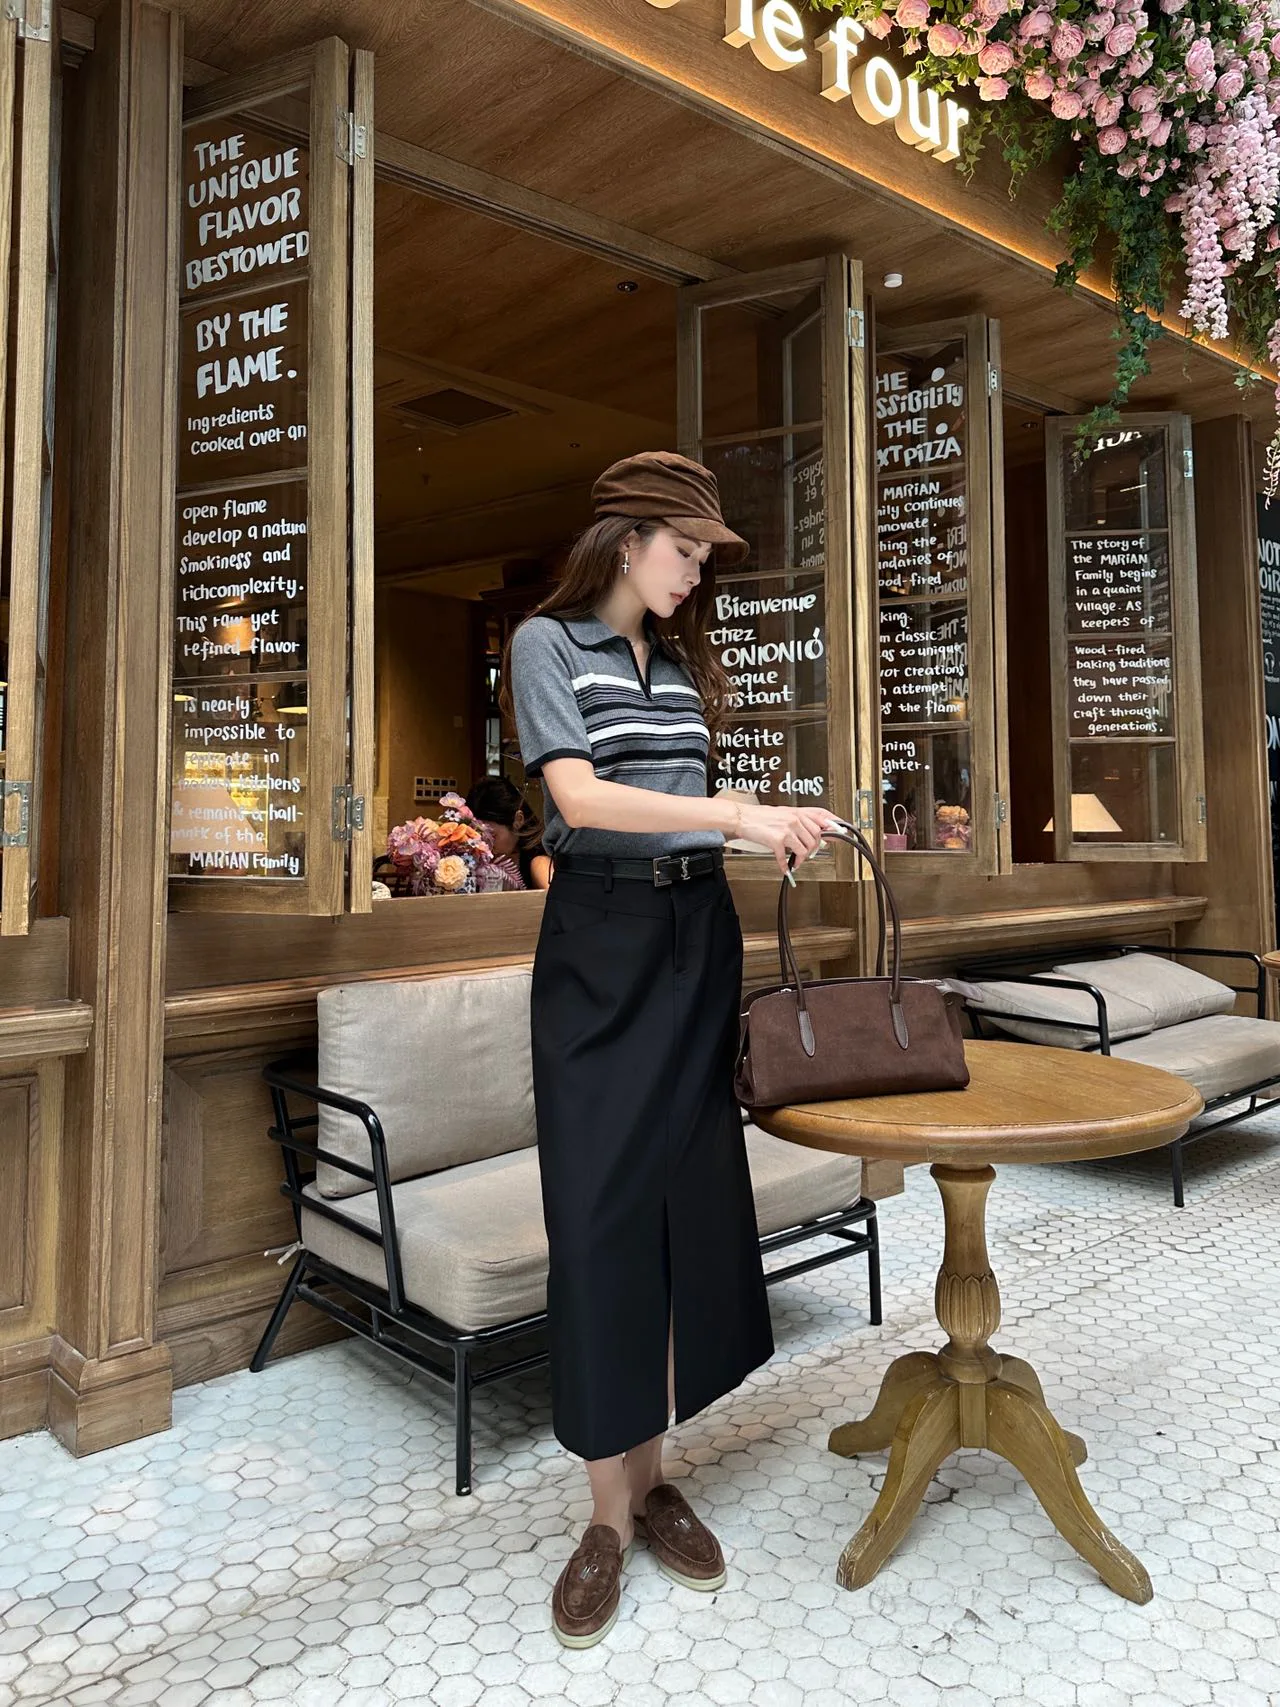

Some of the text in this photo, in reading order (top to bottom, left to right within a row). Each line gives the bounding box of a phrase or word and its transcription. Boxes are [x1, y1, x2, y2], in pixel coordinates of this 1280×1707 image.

[815, 17, 969, 163] four
[194, 133, 246, 171] THE
[198, 187, 301, 246] FLAVOR
[185, 230, 309, 290] BESTOWED
[196, 303, 288, 352] BY THE
[196, 346, 297, 399] FLAME.
[287, 425, 307, 441] an
[883, 418, 927, 439] THE
[183, 500, 267, 524] open flame
[904, 496, 964, 513] continues
[183, 528, 242, 547] develop
[248, 525, 258, 540] a
[912, 537, 937, 548] the
[1071, 538, 1145, 551] The story of
[263, 543, 291, 563] and
[937, 551, 953, 564] of
[1073, 555, 1093, 564] the
[1075, 568, 1157, 583] Family begins
[1076, 584, 1143, 598] in a quaint
[715, 594, 817, 621] Bienvenue
[177, 609, 280, 632] This raw yet
[1140, 616, 1155, 628] of
[895, 631, 937, 643] classic
[184, 637, 300, 661] refined flavor
[899, 649, 915, 657] to
[917, 644, 962, 660] unique
[904, 664, 965, 677] creations
[1076, 660, 1116, 673] baking
[892, 681, 948, 697] attempt
[1073, 676, 1096, 689] they
[1102, 676, 1128, 686] have
[1078, 692, 1149, 703] down their
[202, 696, 250, 719] nearly
[898, 701, 921, 713] the
[1073, 706, 1160, 722] craft through
[185, 724, 296, 746] impossible to
[264, 749, 280, 764] in
[882, 741, 916, 758] ning
[882, 759, 930, 775] ghter.
[778, 771, 824, 797] dans
[216, 827, 232, 844] of
[236, 826, 267, 843] the
[253, 853, 300, 875] Family
